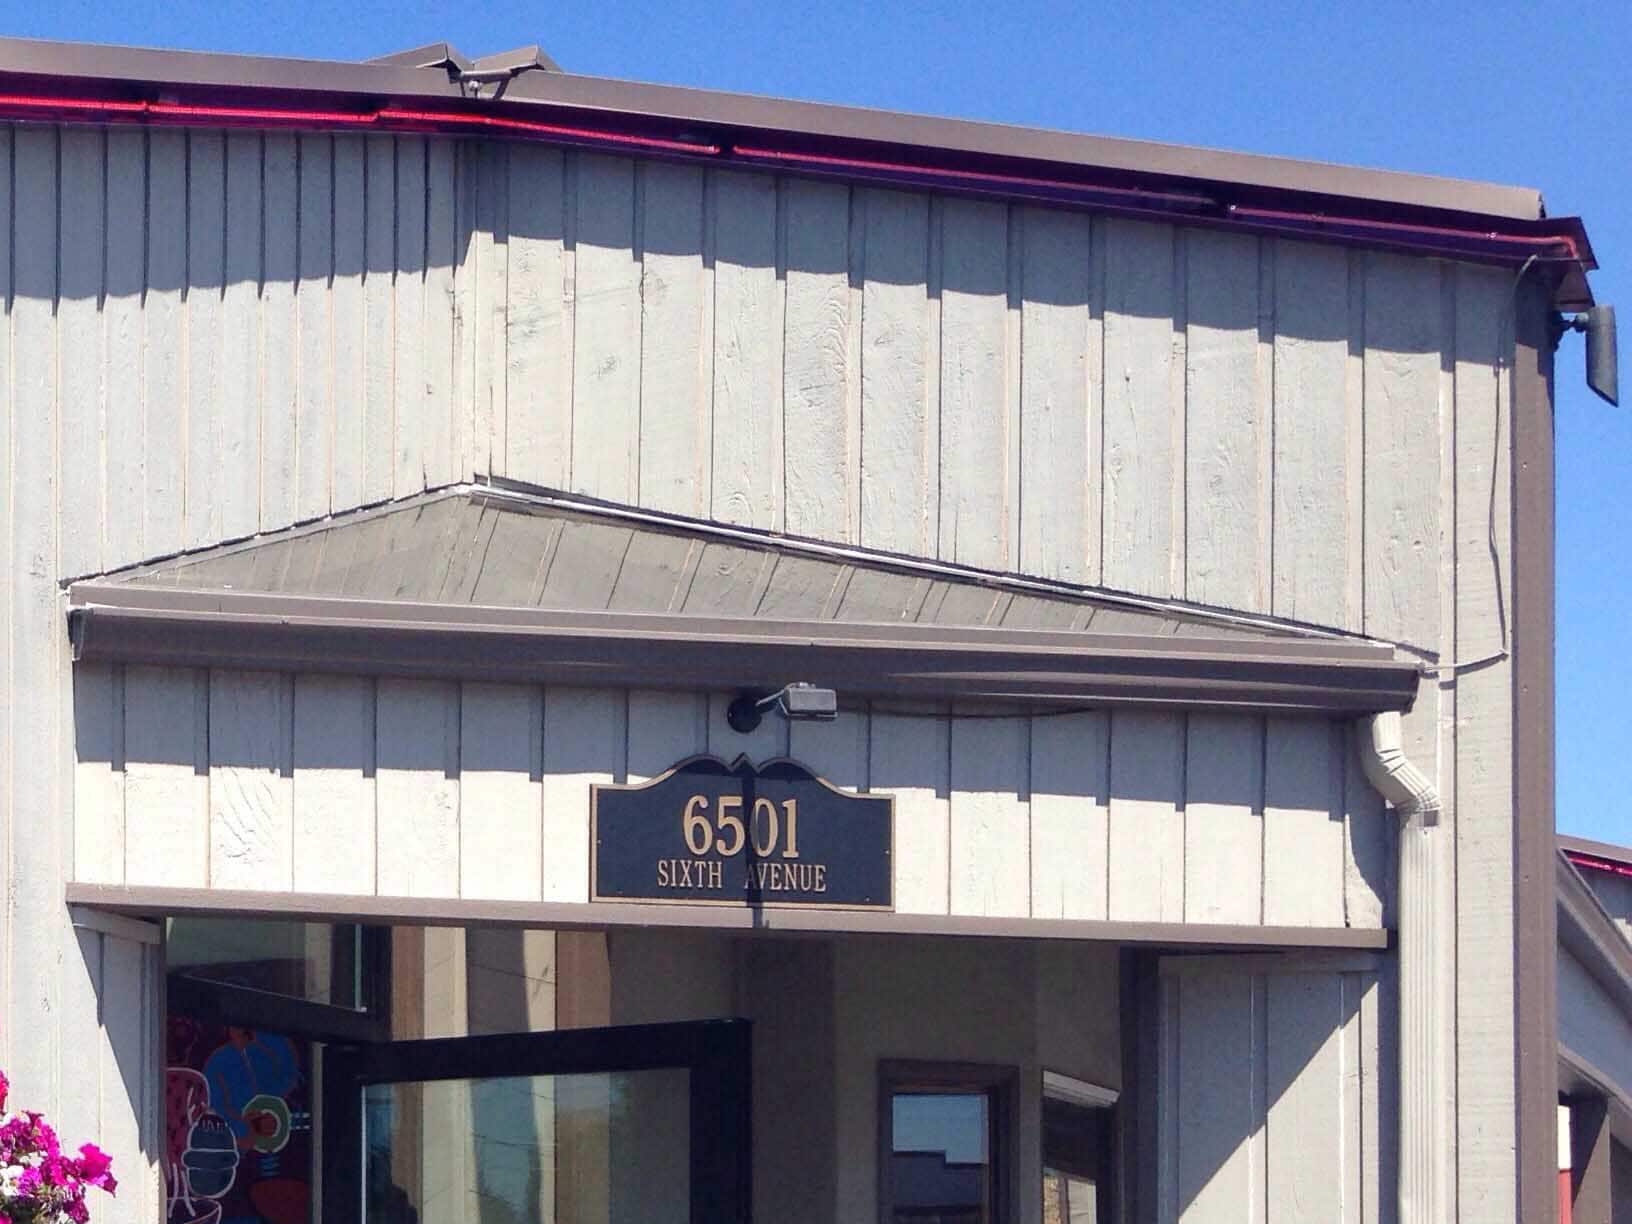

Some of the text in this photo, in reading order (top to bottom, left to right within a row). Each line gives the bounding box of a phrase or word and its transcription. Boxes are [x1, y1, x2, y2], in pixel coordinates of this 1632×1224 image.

[683, 794, 800, 858] 6501
[657, 859, 827, 892] SIXTH AVENUE
